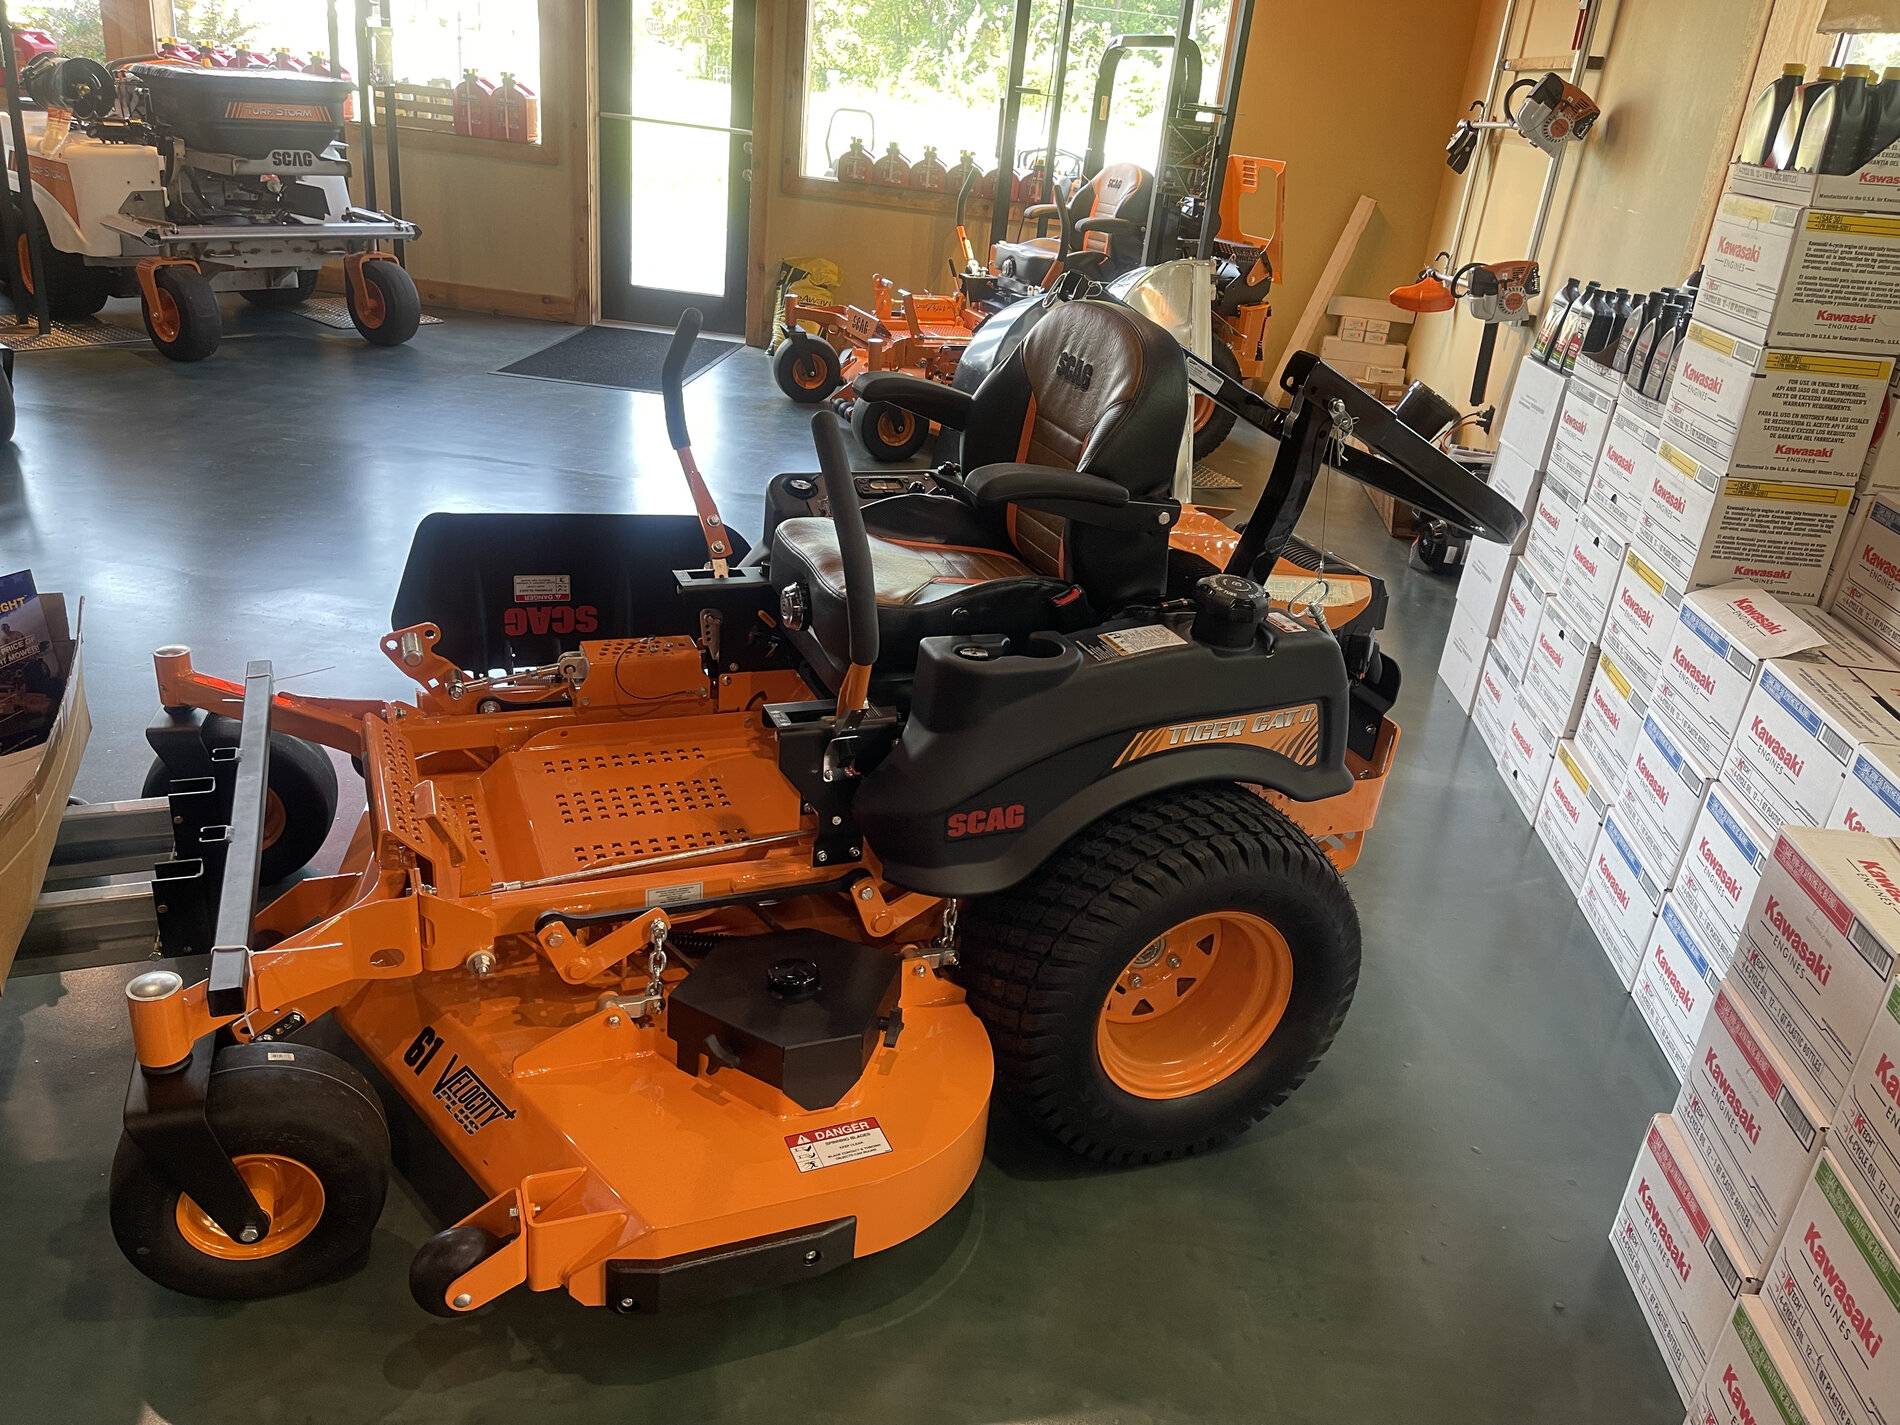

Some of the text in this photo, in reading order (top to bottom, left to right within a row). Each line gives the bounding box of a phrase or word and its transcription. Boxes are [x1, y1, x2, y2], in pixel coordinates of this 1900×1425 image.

[272, 151, 313, 167] SCAG
[1107, 178, 1123, 190] SCAG
[1717, 235, 1761, 263] Kawasaki
[852, 315, 869, 335] SCAG
[1816, 309, 1877, 325] Kawasaki
[1056, 351, 1094, 392] SCAG
[1682, 361, 1724, 395] Kawasaki
[1562, 408, 1588, 436] Kawasaki
[1606, 445, 1636, 475] Kawasaki
[1775, 443, 1834, 458] Kawasaki
[1652, 478, 1687, 514] Kawasaki
[1573, 544, 1598, 578] Kawasaki
[1733, 565, 1793, 580] Kawasaki
[1869, 569, 1895, 592] ENGINES
[503, 605, 599, 636] SCAG
[1621, 586, 1655, 629] Kawasaki
[1733, 597, 1787, 635] Kawasaki
[1672, 645, 1717, 696] Kawasaki
[1678, 670, 1701, 695] ENGINES
[1168, 719, 1247, 745] TIGER
[1250, 710, 1298, 734] CAT
[1593, 686, 1621, 731] Kawasaki
[1751, 715, 1806, 778] Kawasaki
[1757, 744, 1784, 775] ENGINES
[1552, 776, 1580, 824] Kawasaki
[1635, 752, 1670, 806] Kawasaki
[947, 803, 1025, 838] SCAG
[1598, 853, 1631, 911] Kawasaki
[1699, 836, 1743, 902] Kawasaki
[1703, 865, 1726, 898] ENGINES
[1856, 871, 1896, 907] ENGINES
[1764, 894, 1833, 987] Kawasaki
[1772, 936, 1806, 980] ENGINES
[1654, 944, 1696, 1013] Kawasaki
[1658, 971, 1680, 1008] ENGINES
[403, 1025, 445, 1077] 61
[1786, 1019, 1803, 1048] PLASTIC
[1803, 1043, 1822, 1073] BOTTLES
[432, 1053, 517, 1128] VELOCITY
[1704, 1045, 1762, 1146] Kawasaki
[1711, 1085, 1739, 1135] ENGINES
[815, 1121, 869, 1141] DANGER
[1849, 1133, 1877, 1185] 4-CYCLE OIL
[1720, 1171, 1735, 1201] PLASTIC
[1734, 1197, 1751, 1229] BOTTLES
[1637, 1175, 1692, 1283] Kawasaki
[1643, 1216, 1671, 1270] ENGINES
[1803, 1220, 1883, 1360] Kawasaki
[1812, 1277, 1853, 1342] ENGINES
[1654, 1301, 1669, 1334] PLASTIC
[1667, 1330, 1683, 1363] BOTTLES
[1795, 1326, 1805, 1345] OIL
[1825, 1378, 1846, 1421] PLASTIC
